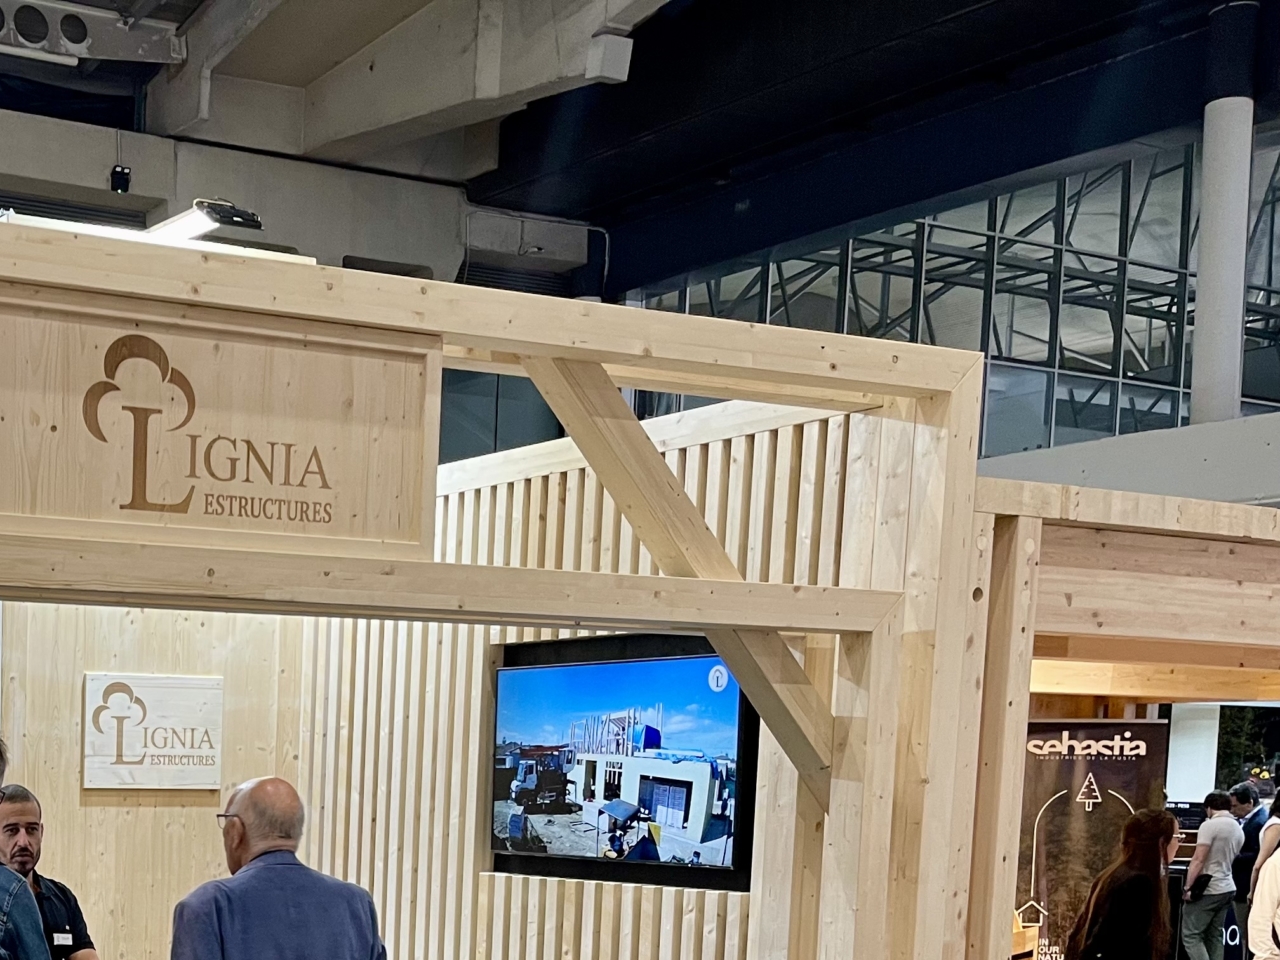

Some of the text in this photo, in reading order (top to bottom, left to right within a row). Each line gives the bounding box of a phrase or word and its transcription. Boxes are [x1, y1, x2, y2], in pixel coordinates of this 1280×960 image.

[119, 405, 333, 515] LIGNIA
[203, 492, 333, 525] ESTRUCTURES
[110, 716, 216, 766] LIGNIA
[150, 754, 216, 767] ESTRUCTURES
[1038, 946, 1060, 954] OUR
[1039, 938, 1049, 946] IN
